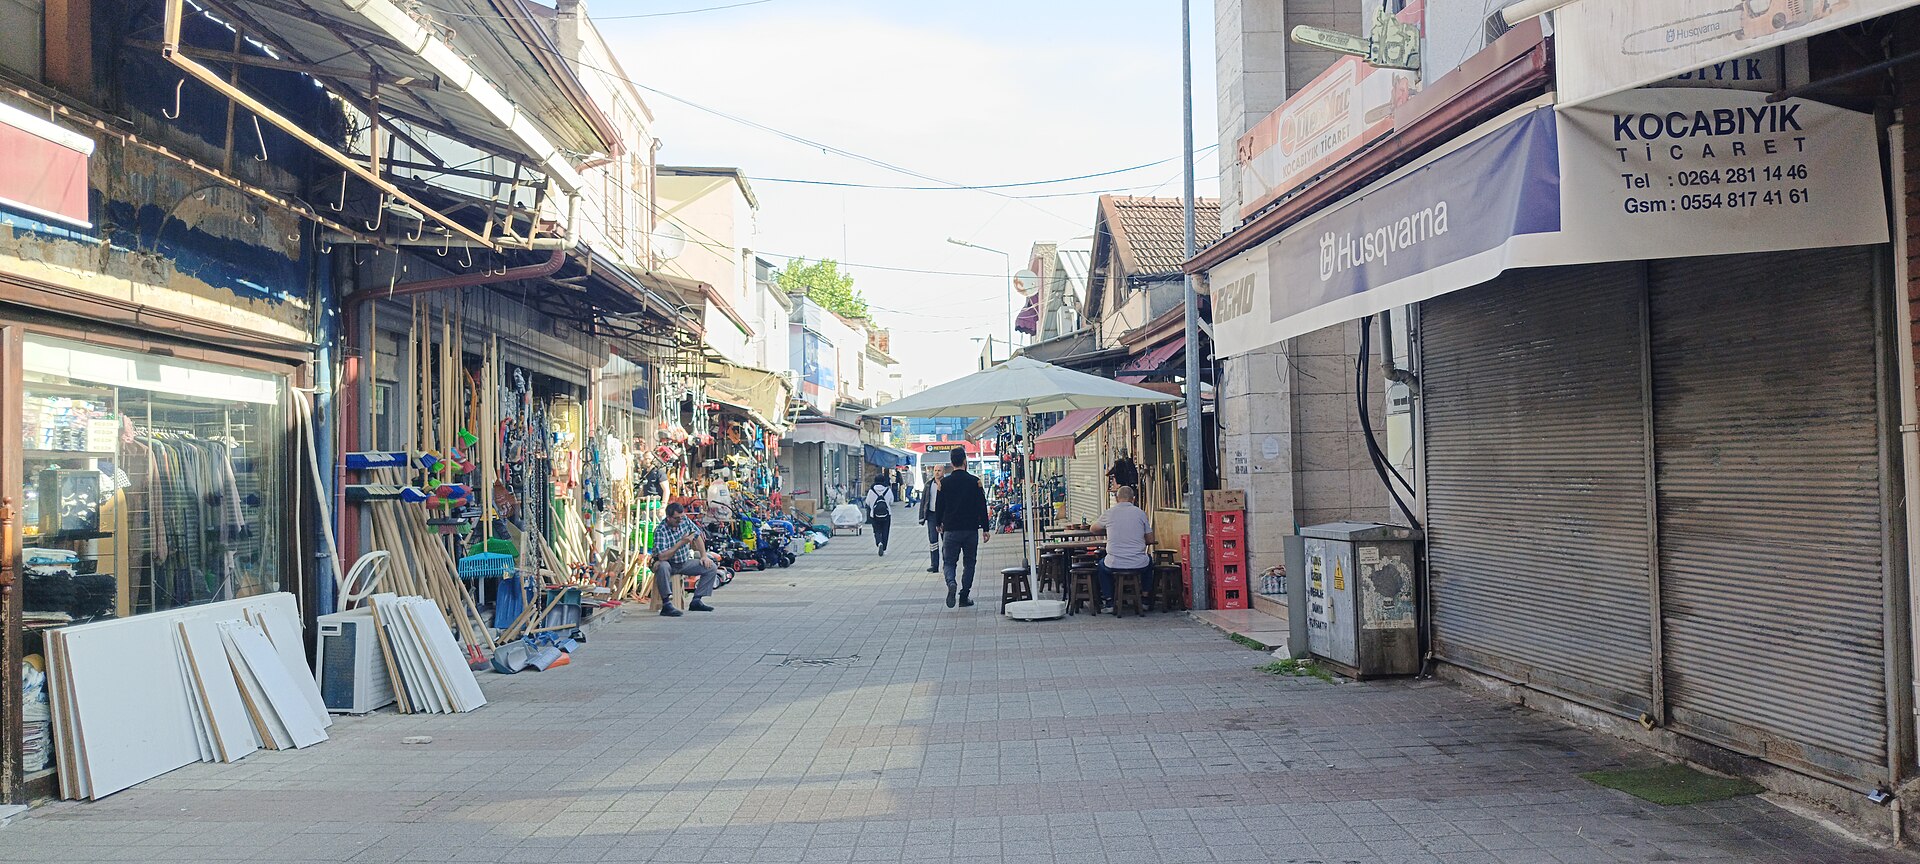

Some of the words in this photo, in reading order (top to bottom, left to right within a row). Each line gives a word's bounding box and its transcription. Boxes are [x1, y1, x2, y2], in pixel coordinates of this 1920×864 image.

[1677, 21, 1720, 40] Husqvarna
[1613, 104, 1803, 141] KOCABIYIK
[1282, 144, 1319, 178] KOCABIYIK
[1320, 124, 1351, 154] TİCARET
[1621, 173, 1650, 189] Tel
[1677, 169, 1721, 186] 0264
[1726, 167, 1756, 183] 281
[1763, 165, 1782, 181] 14
[1786, 164, 1808, 180] 46
[1624, 197, 1667, 214] Gsm
[1680, 193, 1722, 211] 0554
[1727, 191, 1758, 208] 817
[1763, 190, 1783, 206] 41
[1789, 187, 1809, 203] 61
[1337, 200, 1448, 272] Husqvarna
[1213, 272, 1256, 325] ECHO
